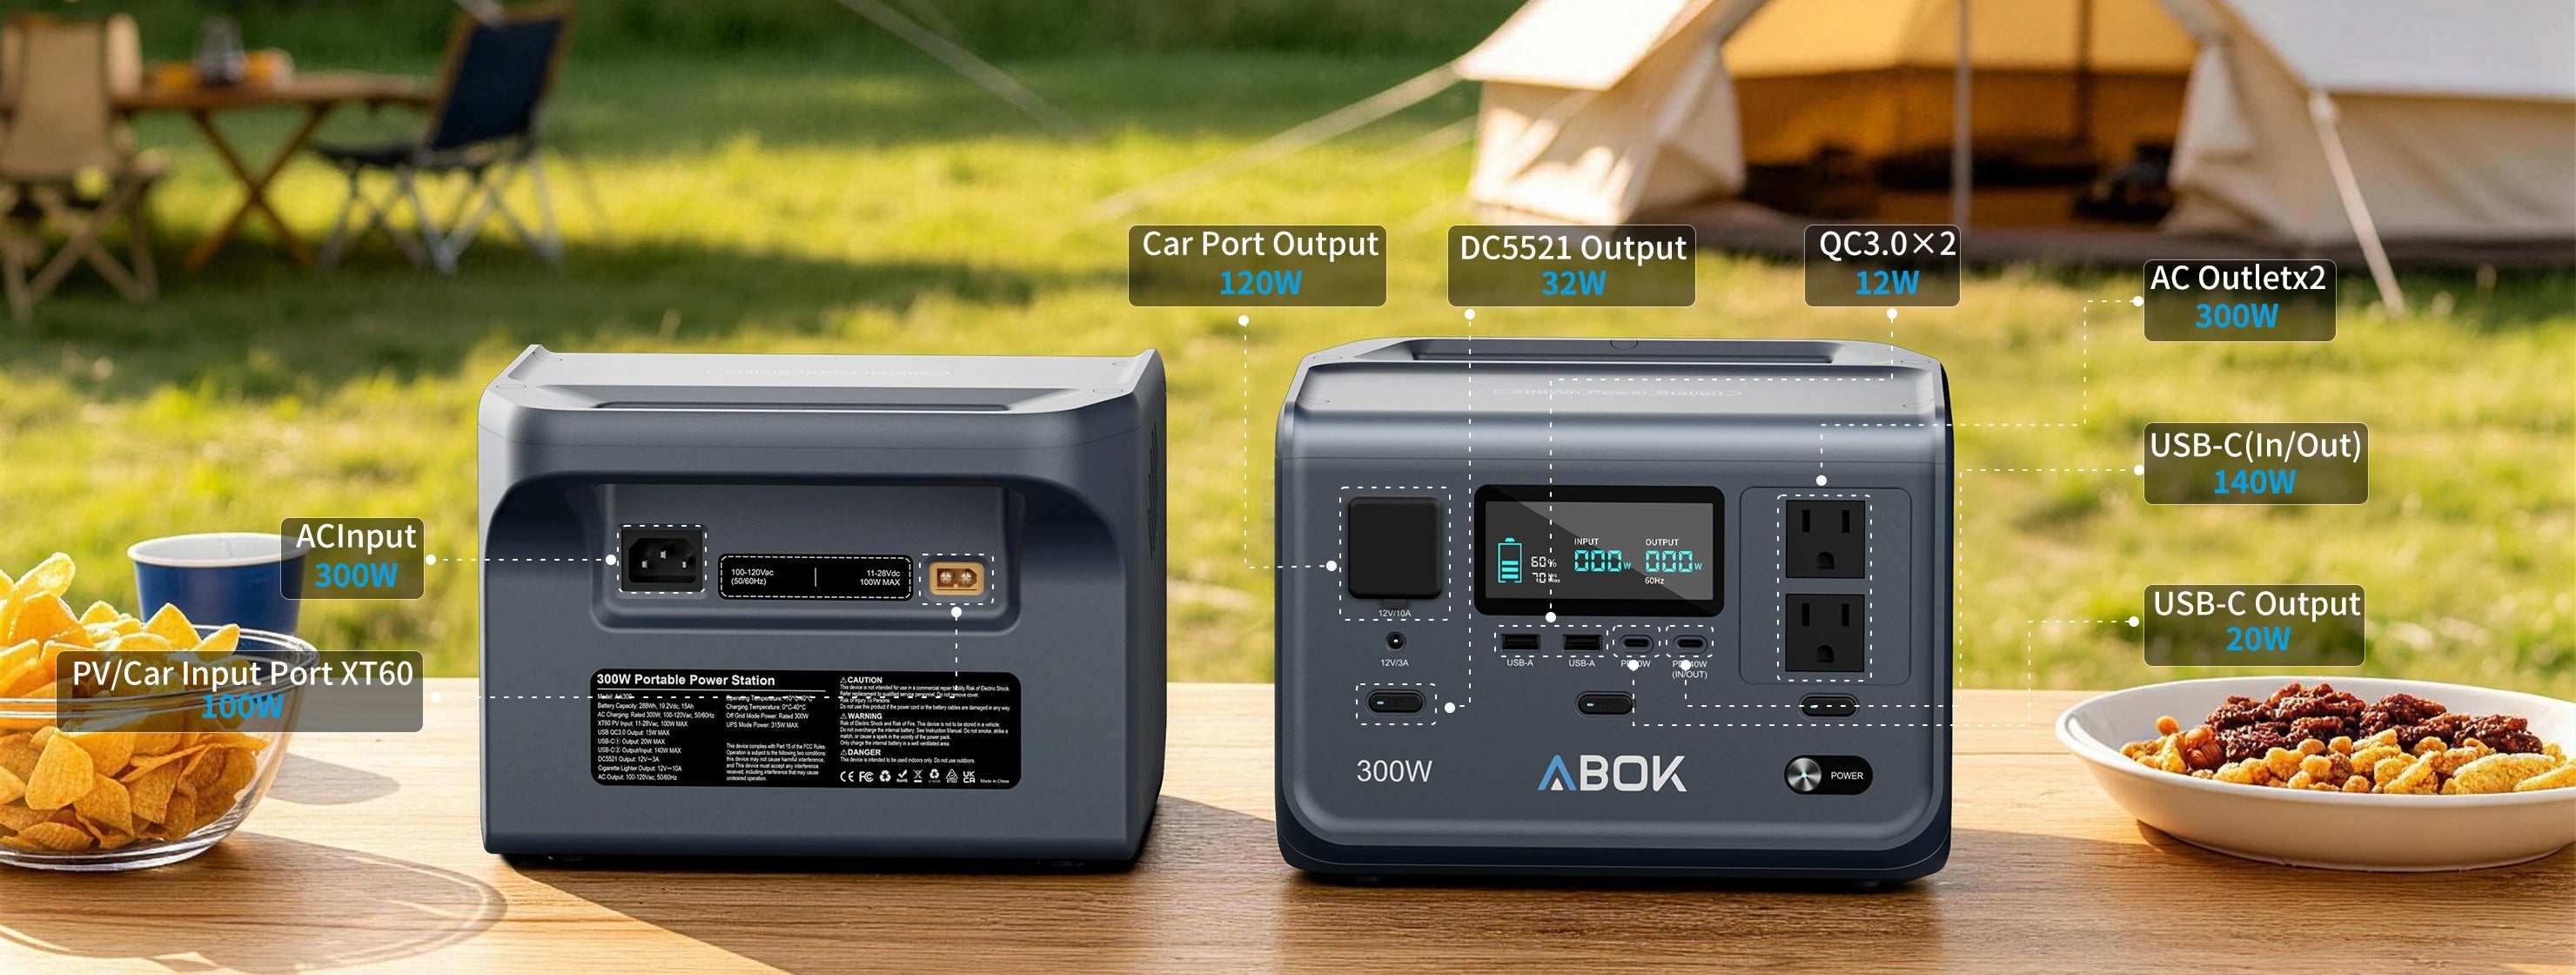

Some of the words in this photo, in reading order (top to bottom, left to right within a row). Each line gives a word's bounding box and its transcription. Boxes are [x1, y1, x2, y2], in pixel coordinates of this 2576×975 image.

[1574, 537, 1600, 546] INPUT
[1645, 538, 1679, 547] OUTPUT
[731, 577, 767, 586] (50/60Hz)
[1645, 576, 1665, 585] 60Hz
[1381, 658, 1409, 667] 12V/3A
[1506, 658, 1534, 667] USB-A
[1673, 670, 1707, 679] (IN/OUT)
[597, 673, 631, 684] 300W
[634, 674, 686, 685] Portable
[689, 674, 728, 685] Power
[731, 674, 775, 686] Station
[848, 676, 882, 684] CAUTION
[848, 748, 882, 756] DANGER
[1358, 760, 1432, 782] 300W
[1538, 755, 1687, 791] ABOK
[1831, 771, 1863, 780] POWER
